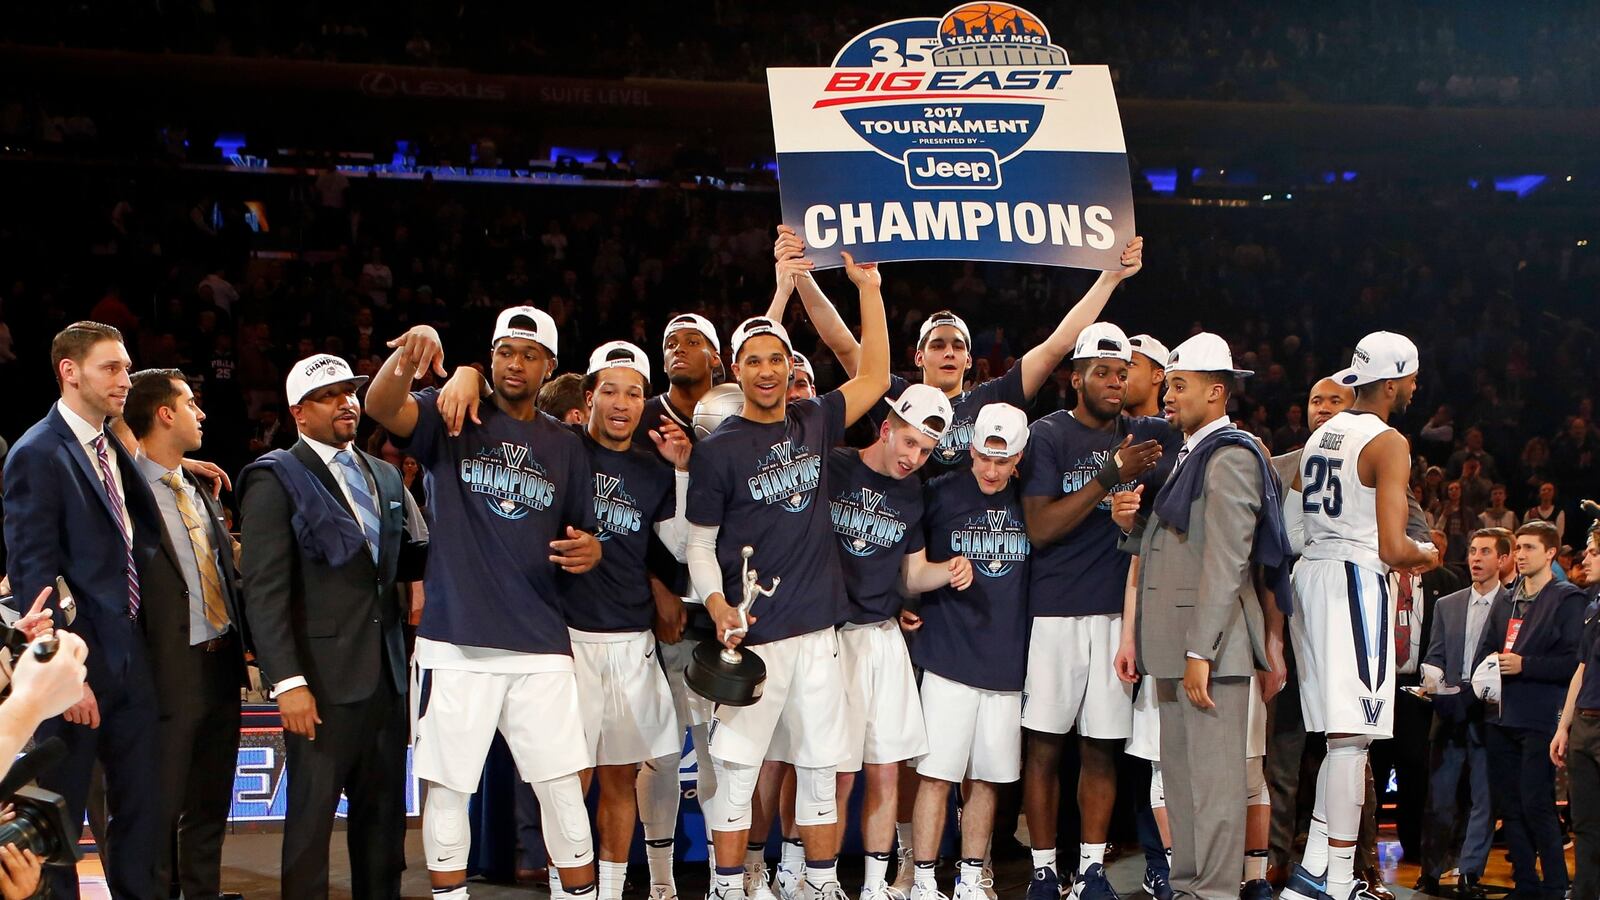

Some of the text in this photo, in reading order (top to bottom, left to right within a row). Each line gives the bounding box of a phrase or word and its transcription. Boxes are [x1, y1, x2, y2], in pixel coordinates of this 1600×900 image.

[947, 34, 1042, 45] YEAR AT MSG
[824, 70, 1073, 92] BIG EAST
[923, 107, 963, 118] 2017
[860, 120, 1030, 134] TOURNAMENT
[915, 156, 991, 182] Jeep
[804, 201, 1115, 250] CHAMPIONS
[461, 458, 555, 507] CHAMPIONS
[748, 454, 821, 501] CHAMPIONS
[1302, 454, 1345, 519] 25
